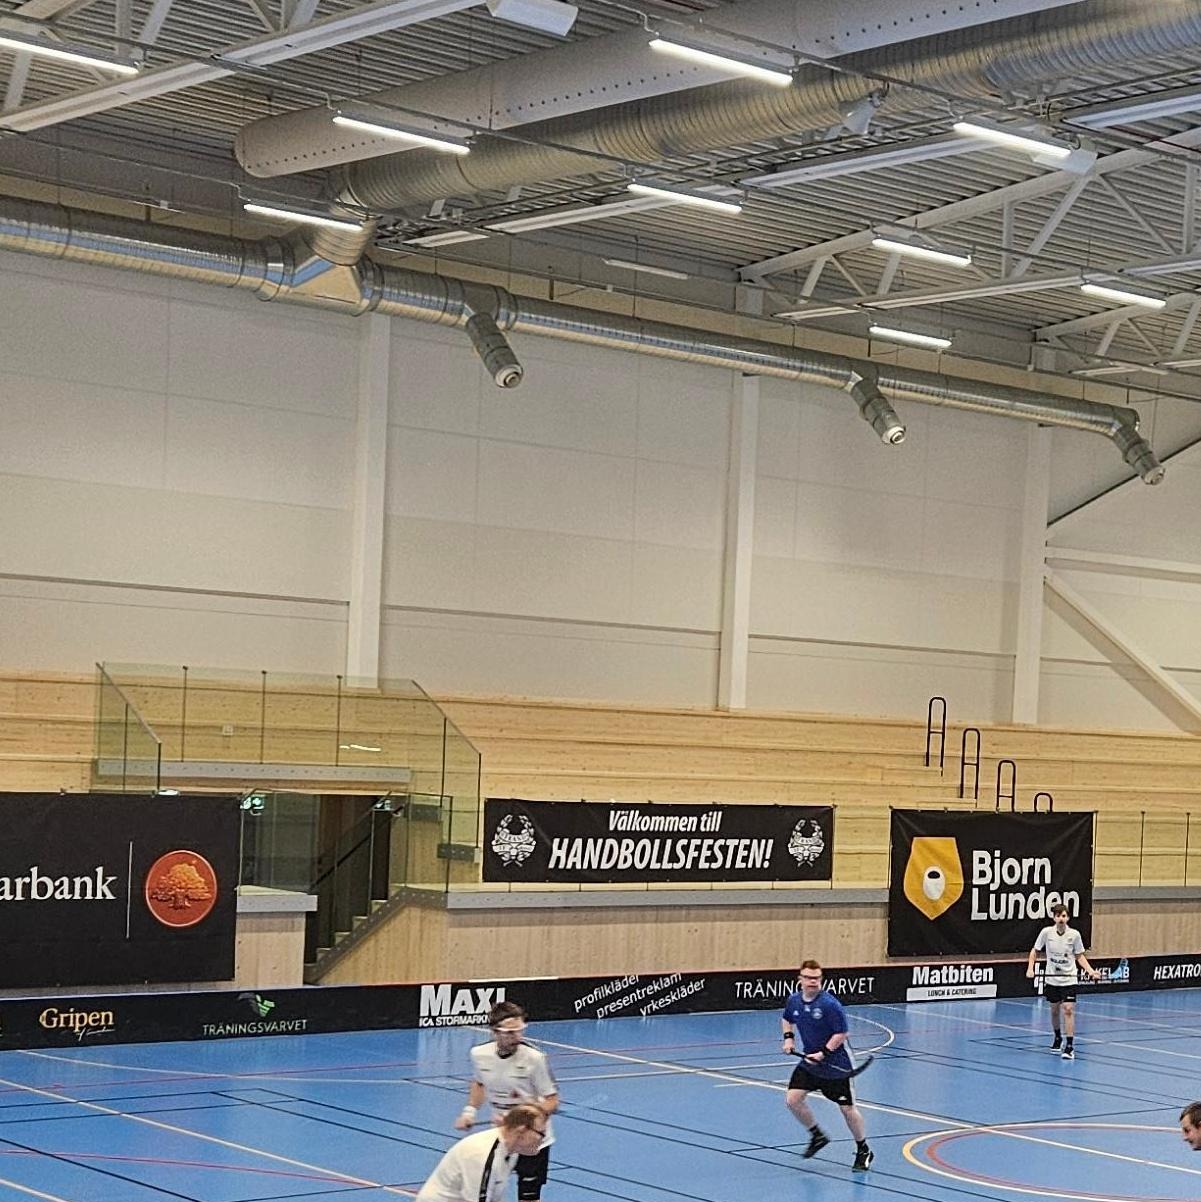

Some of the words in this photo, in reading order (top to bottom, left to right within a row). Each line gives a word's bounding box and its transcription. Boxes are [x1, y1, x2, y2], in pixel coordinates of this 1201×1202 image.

[608, 810, 697, 832] Välkommen
[699, 811, 723, 832] till
[547, 837, 774, 870] HANDBOLLSFESTEN!
[971, 849, 1052, 891] Bjorn
[0, 866, 118, 901] arbank
[970, 885, 1080, 921] Lunden
[735, 977, 875, 999] TRÄNINARVET
[912, 965, 994, 985] Matbiten
[419, 983, 506, 1017] MAXI
[596, 973, 682, 1019] presentreklam
[639, 979, 706, 1017] yrkeskläder
[40, 1007, 115, 1033] Gripen
[202, 1020, 308, 1036] TRÄNINGSVARVET
[418, 1017, 435, 1027] ICA
